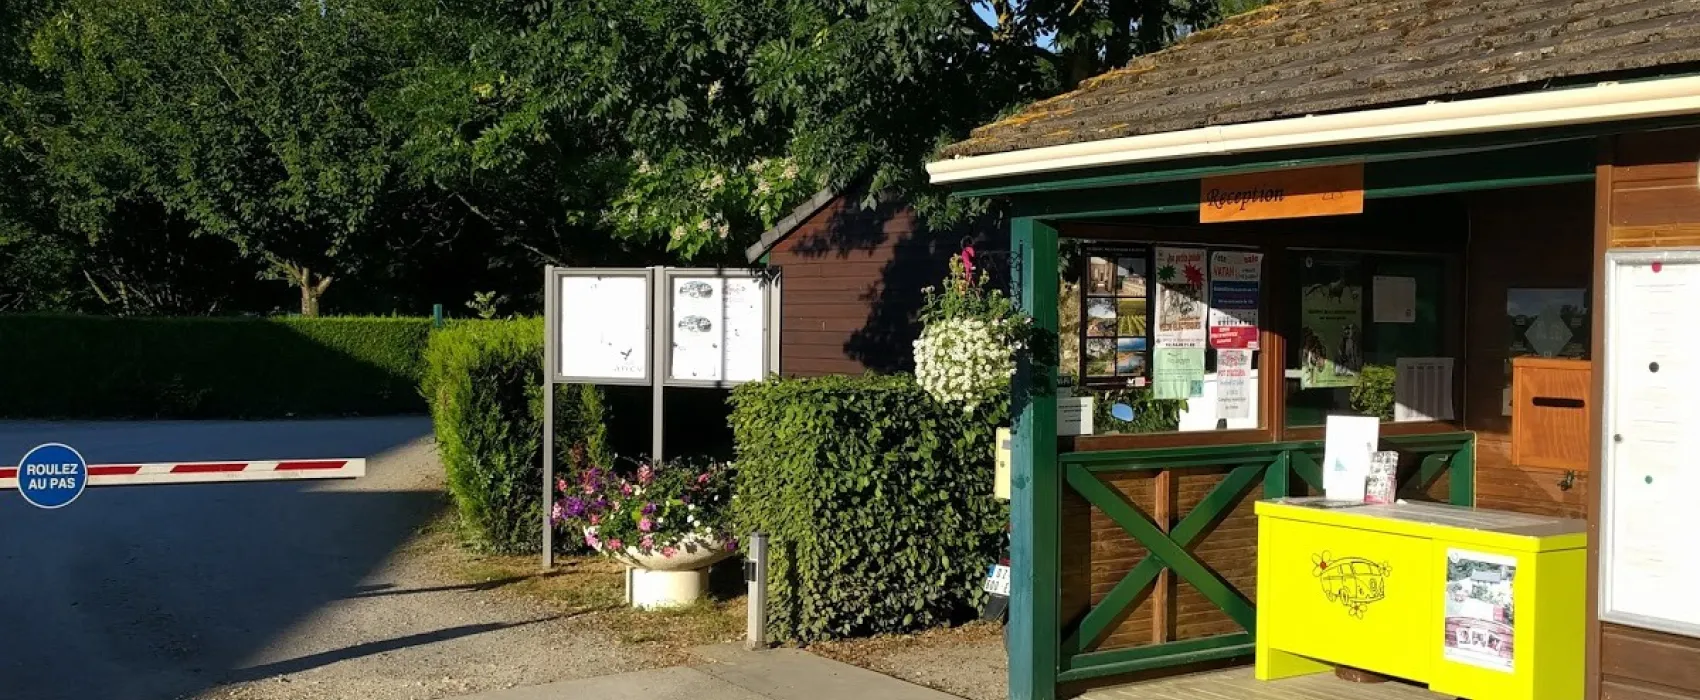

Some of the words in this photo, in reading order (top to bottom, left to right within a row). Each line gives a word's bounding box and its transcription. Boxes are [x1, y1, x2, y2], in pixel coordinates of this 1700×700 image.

[1207, 186, 1284, 210] Reception
[27, 463, 78, 475] ROULEZ
[28, 478, 46, 489] AU
[50, 478, 75, 489] PAS
